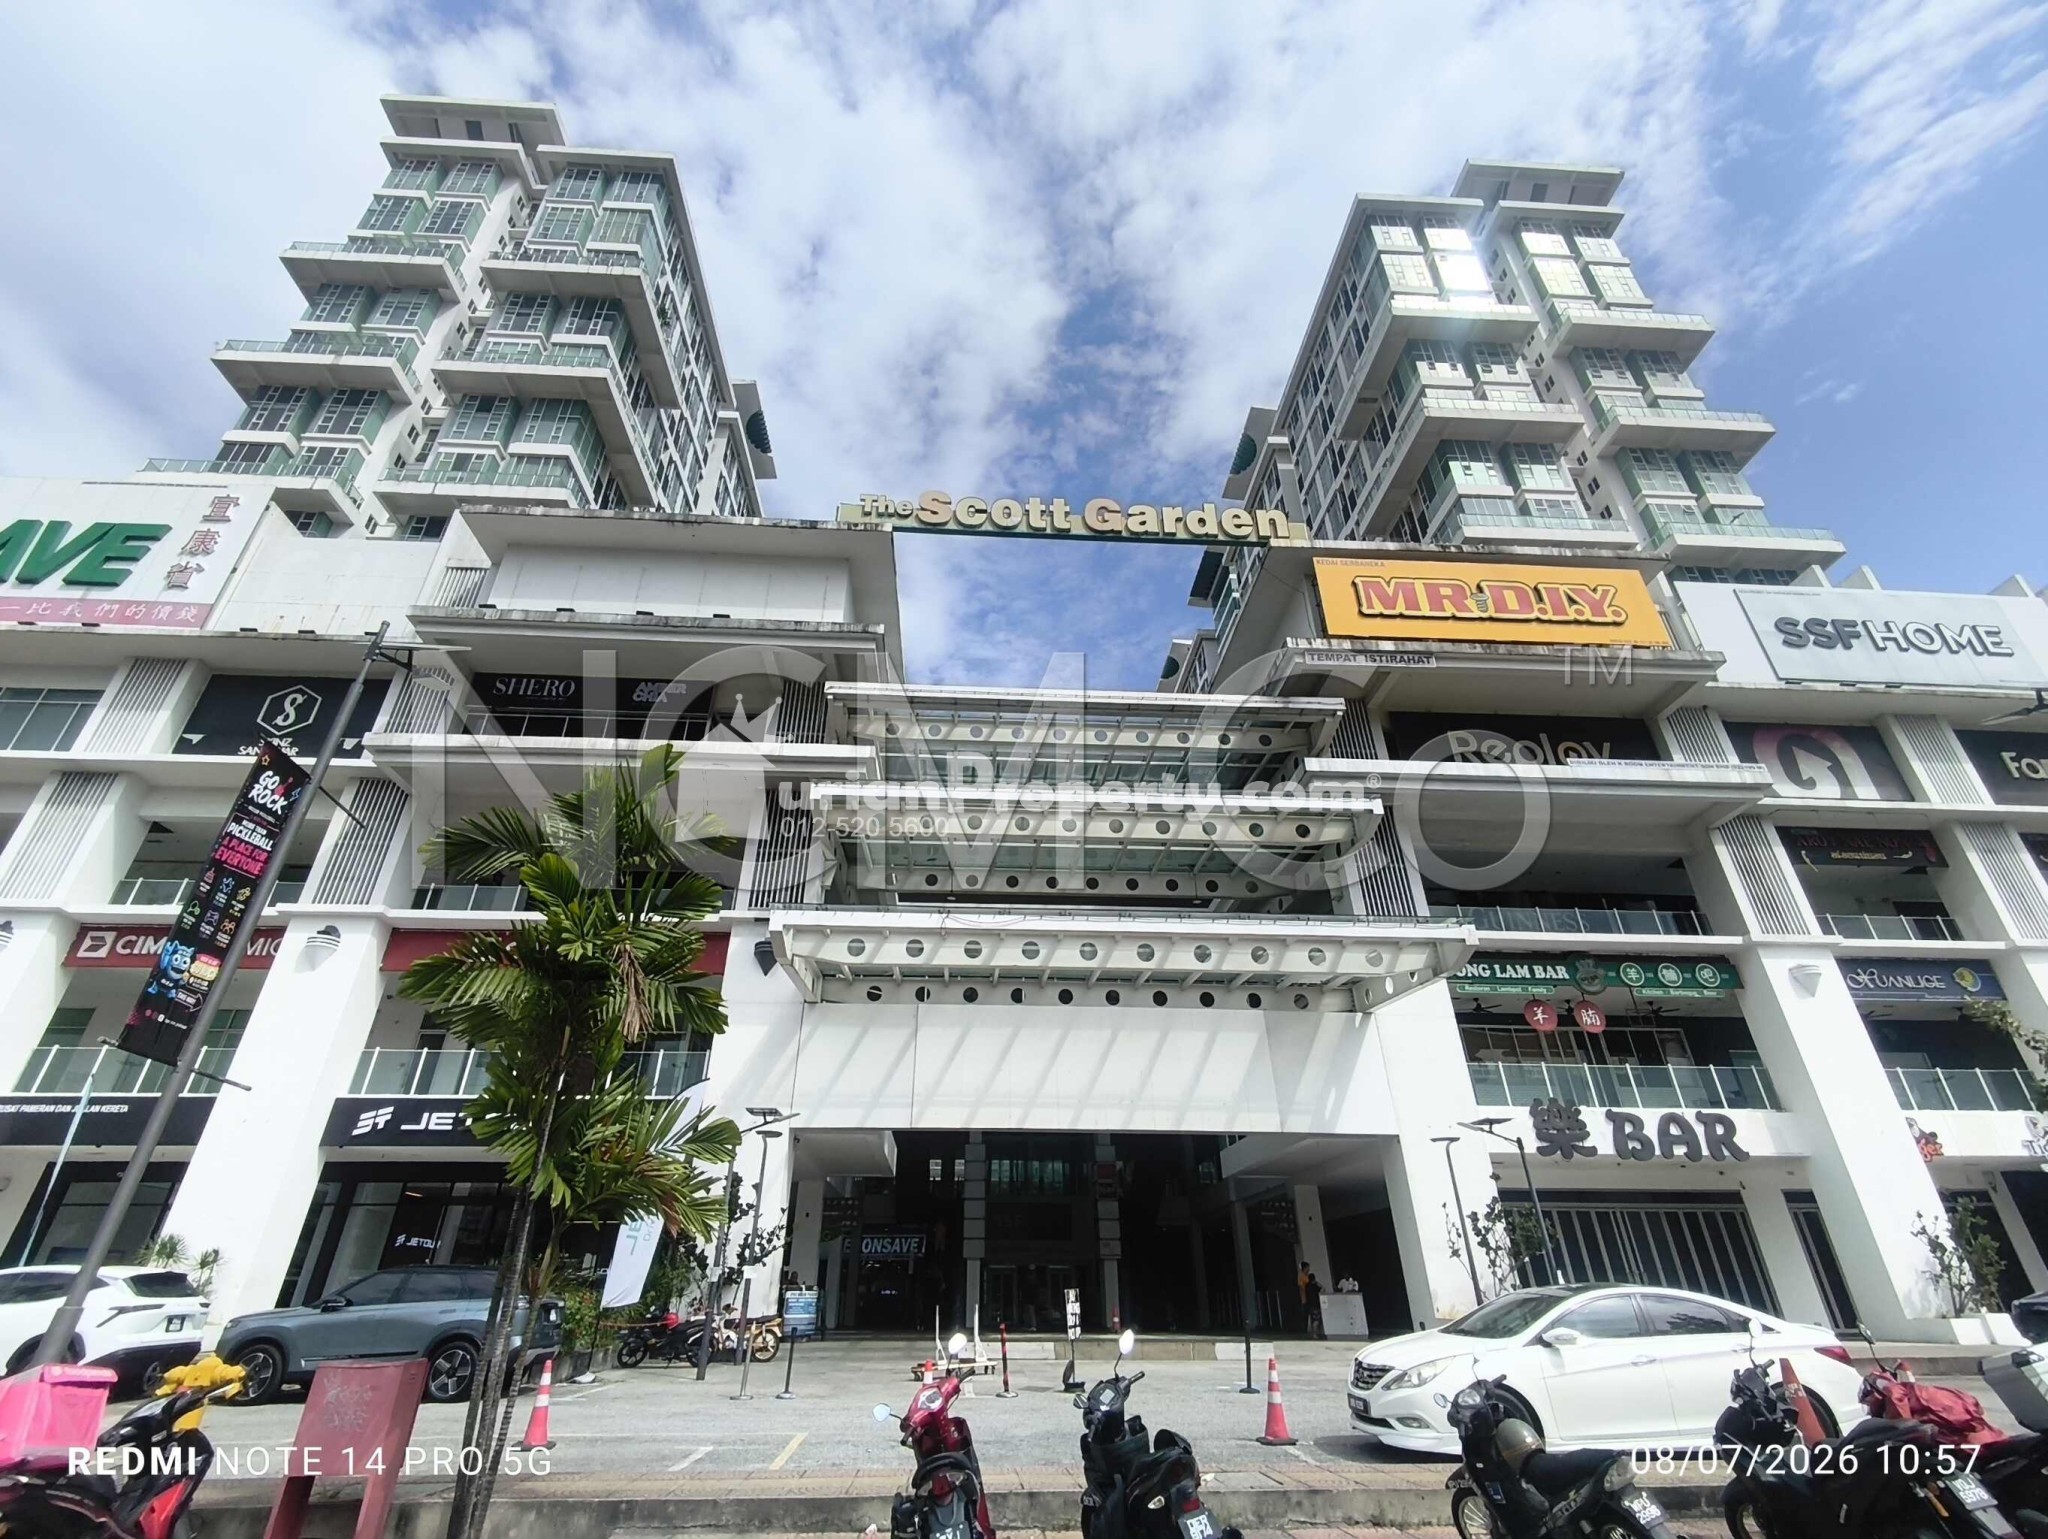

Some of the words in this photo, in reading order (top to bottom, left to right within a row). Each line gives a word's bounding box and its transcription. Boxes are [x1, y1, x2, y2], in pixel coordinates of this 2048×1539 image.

[860, 494, 914, 519] The
[917, 490, 1071, 533] Scott
[1084, 498, 1290, 540] Garden
[168, 494, 240, 590] 宜康省
[1309, 652, 1359, 663] TEMPAT
[1364, 654, 1432, 665] ISTIRAHAT
[493, 677, 576, 697] SHERO
[259, 771, 280, 789] GO
[248, 783, 288, 815] ROCK
[227, 822, 274, 851] PICKLEBALL
[115, 935, 169, 955] CIM
[1493, 964, 1531, 979] LAM
[1533, 965, 1570, 980] BAR
[1532, 1006, 1550, 1025] 羊
[19, 1104, 56, 1113] PAMERAN
[55, 1104, 73, 1113] DAN
[100, 1104, 129, 1113] KERETA
[1605, 1108, 1750, 1162] BAR
[843, 1238, 919, 1254] EONSAVE
